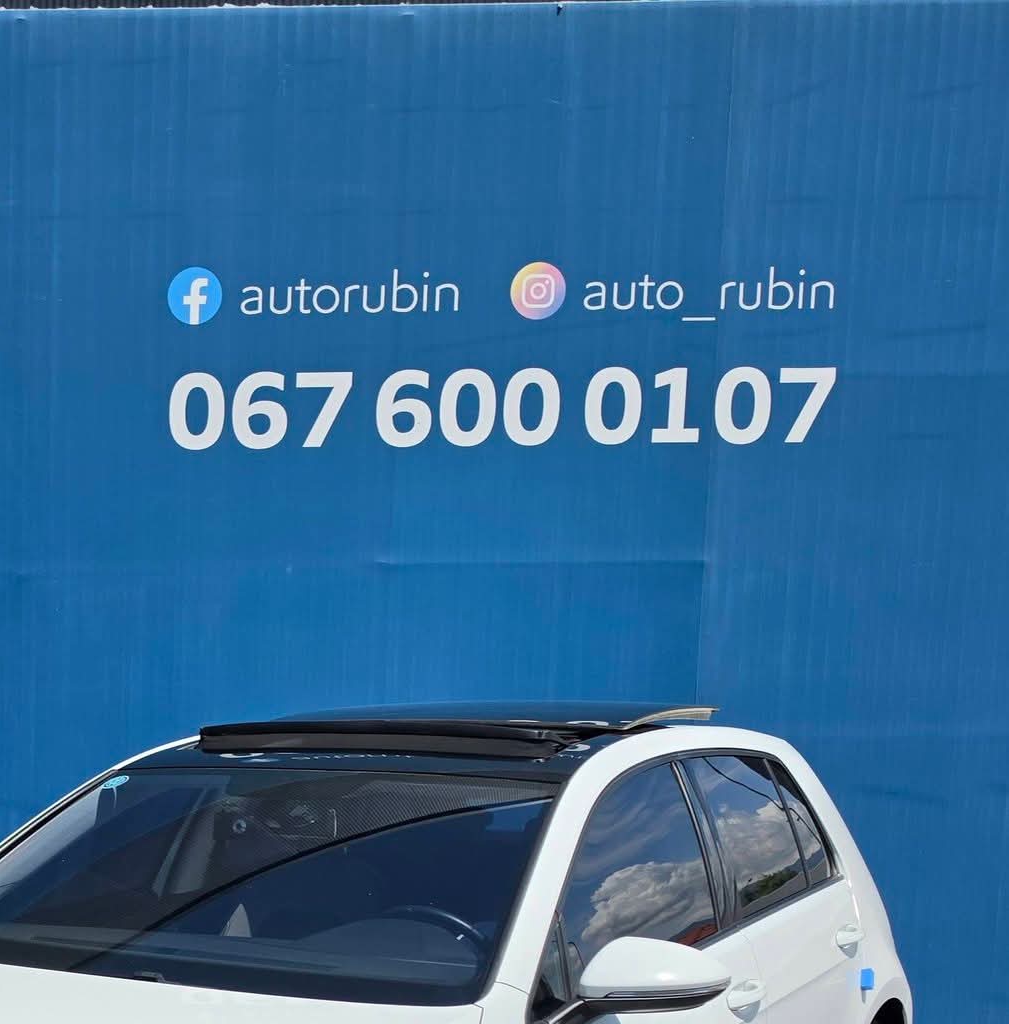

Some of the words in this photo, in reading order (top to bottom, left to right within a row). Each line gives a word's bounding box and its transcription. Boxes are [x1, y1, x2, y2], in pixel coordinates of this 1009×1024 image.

[240, 268, 460, 315] autorubin
[583, 266, 835, 322] auto_rubin
[168, 371, 354, 451] 067
[375, 367, 561, 448] 600
[584, 366, 837, 445] 0107
